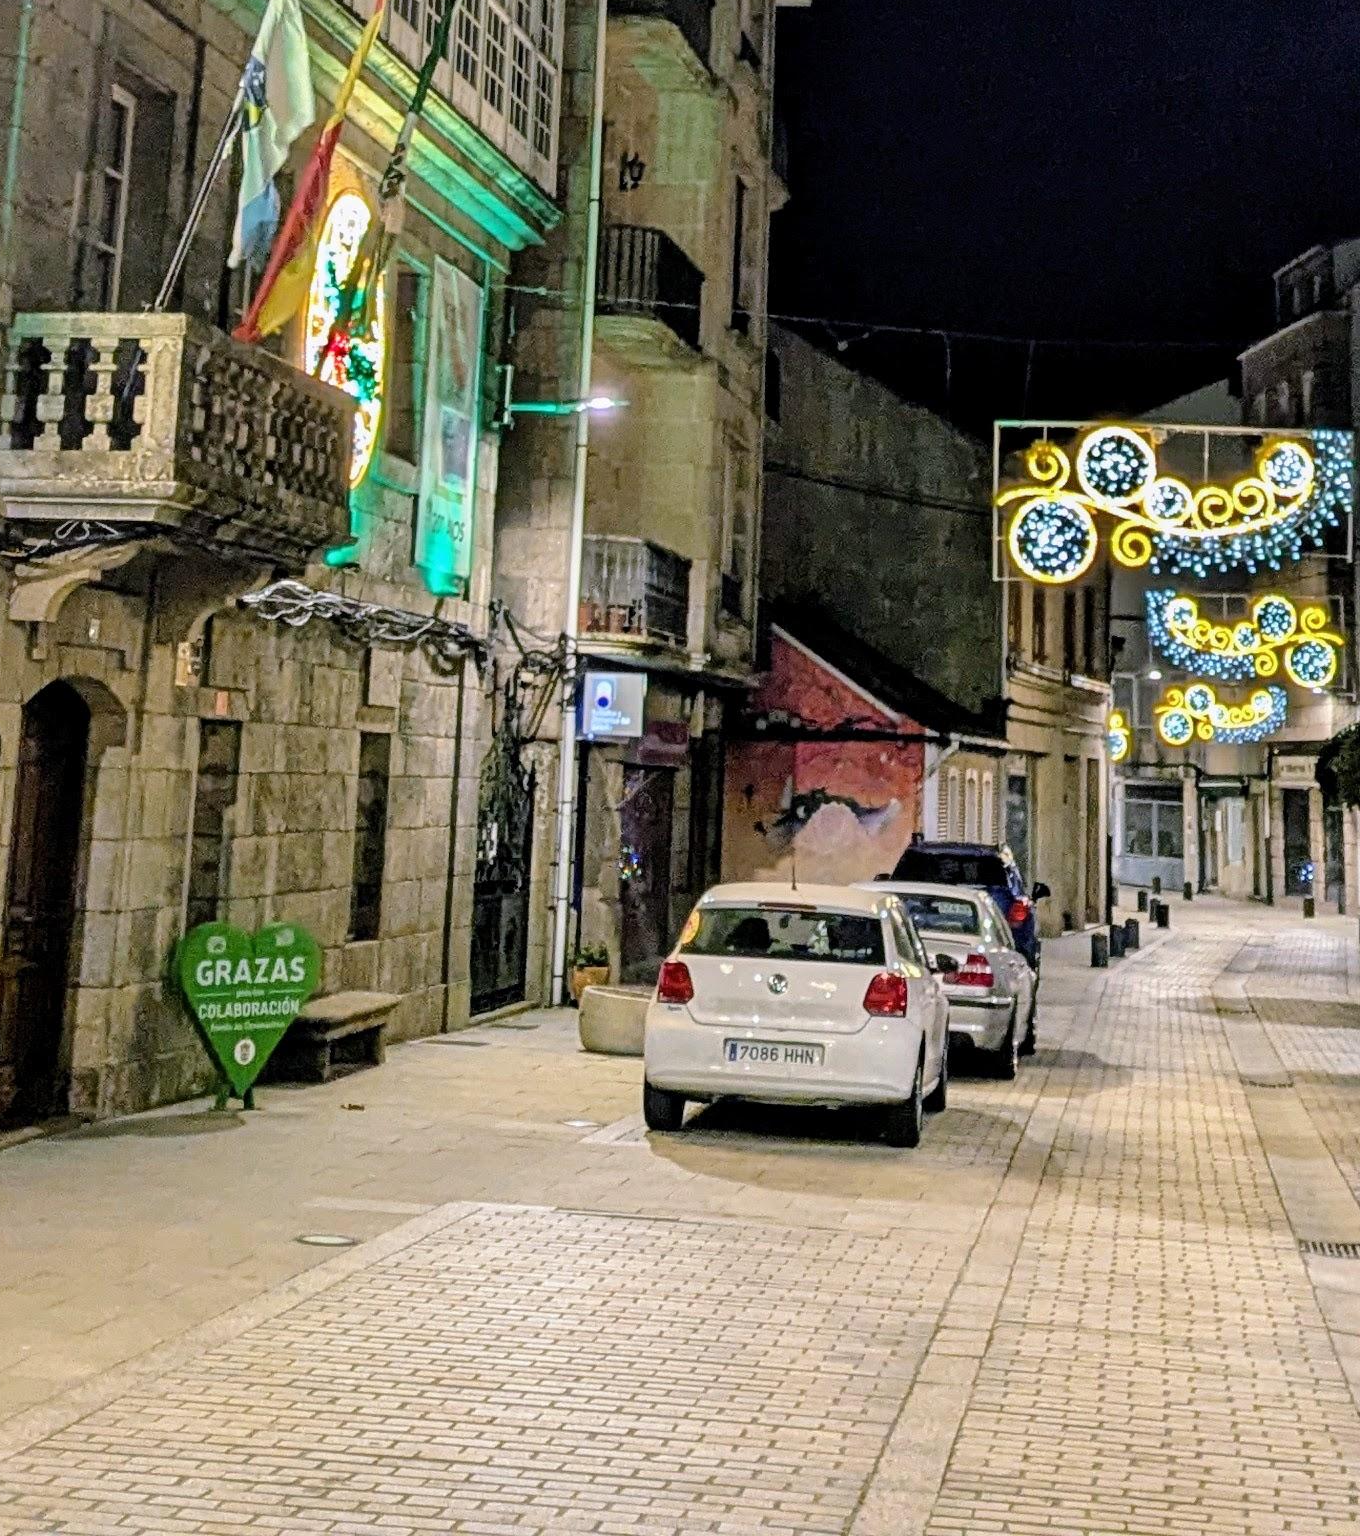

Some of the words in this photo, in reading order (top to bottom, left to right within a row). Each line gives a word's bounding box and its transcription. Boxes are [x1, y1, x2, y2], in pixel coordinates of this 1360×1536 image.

[196, 956, 306, 987] GRAZAS
[198, 995, 300, 1020] COLABORACIÓN
[739, 1045, 780, 1062] 7086
[784, 1047, 815, 1065] HHN
